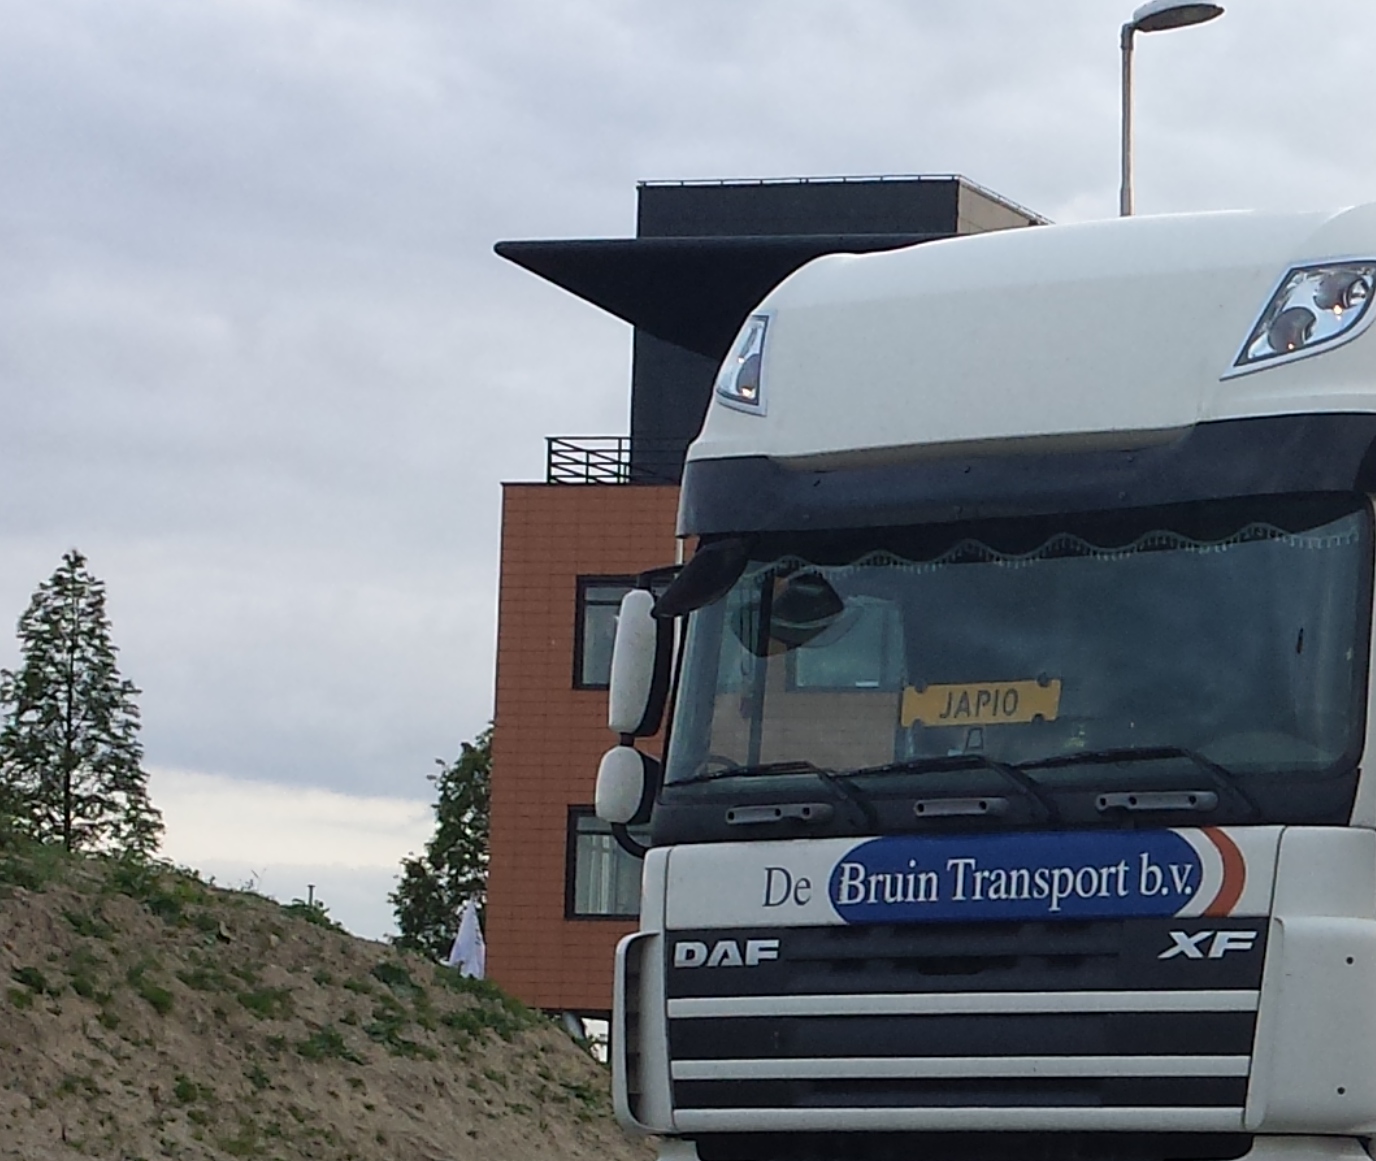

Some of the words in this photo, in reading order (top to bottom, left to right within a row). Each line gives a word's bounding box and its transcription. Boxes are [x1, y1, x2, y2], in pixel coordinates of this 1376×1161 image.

[939, 688, 1019, 719] JAPIO
[763, 866, 812, 907] De
[838, 858, 939, 905] Bruin
[947, 856, 1129, 911] Transport
[1138, 852, 1194, 898] b.v.
[673, 938, 781, 968] DAF
[1157, 930, 1259, 960] XF
